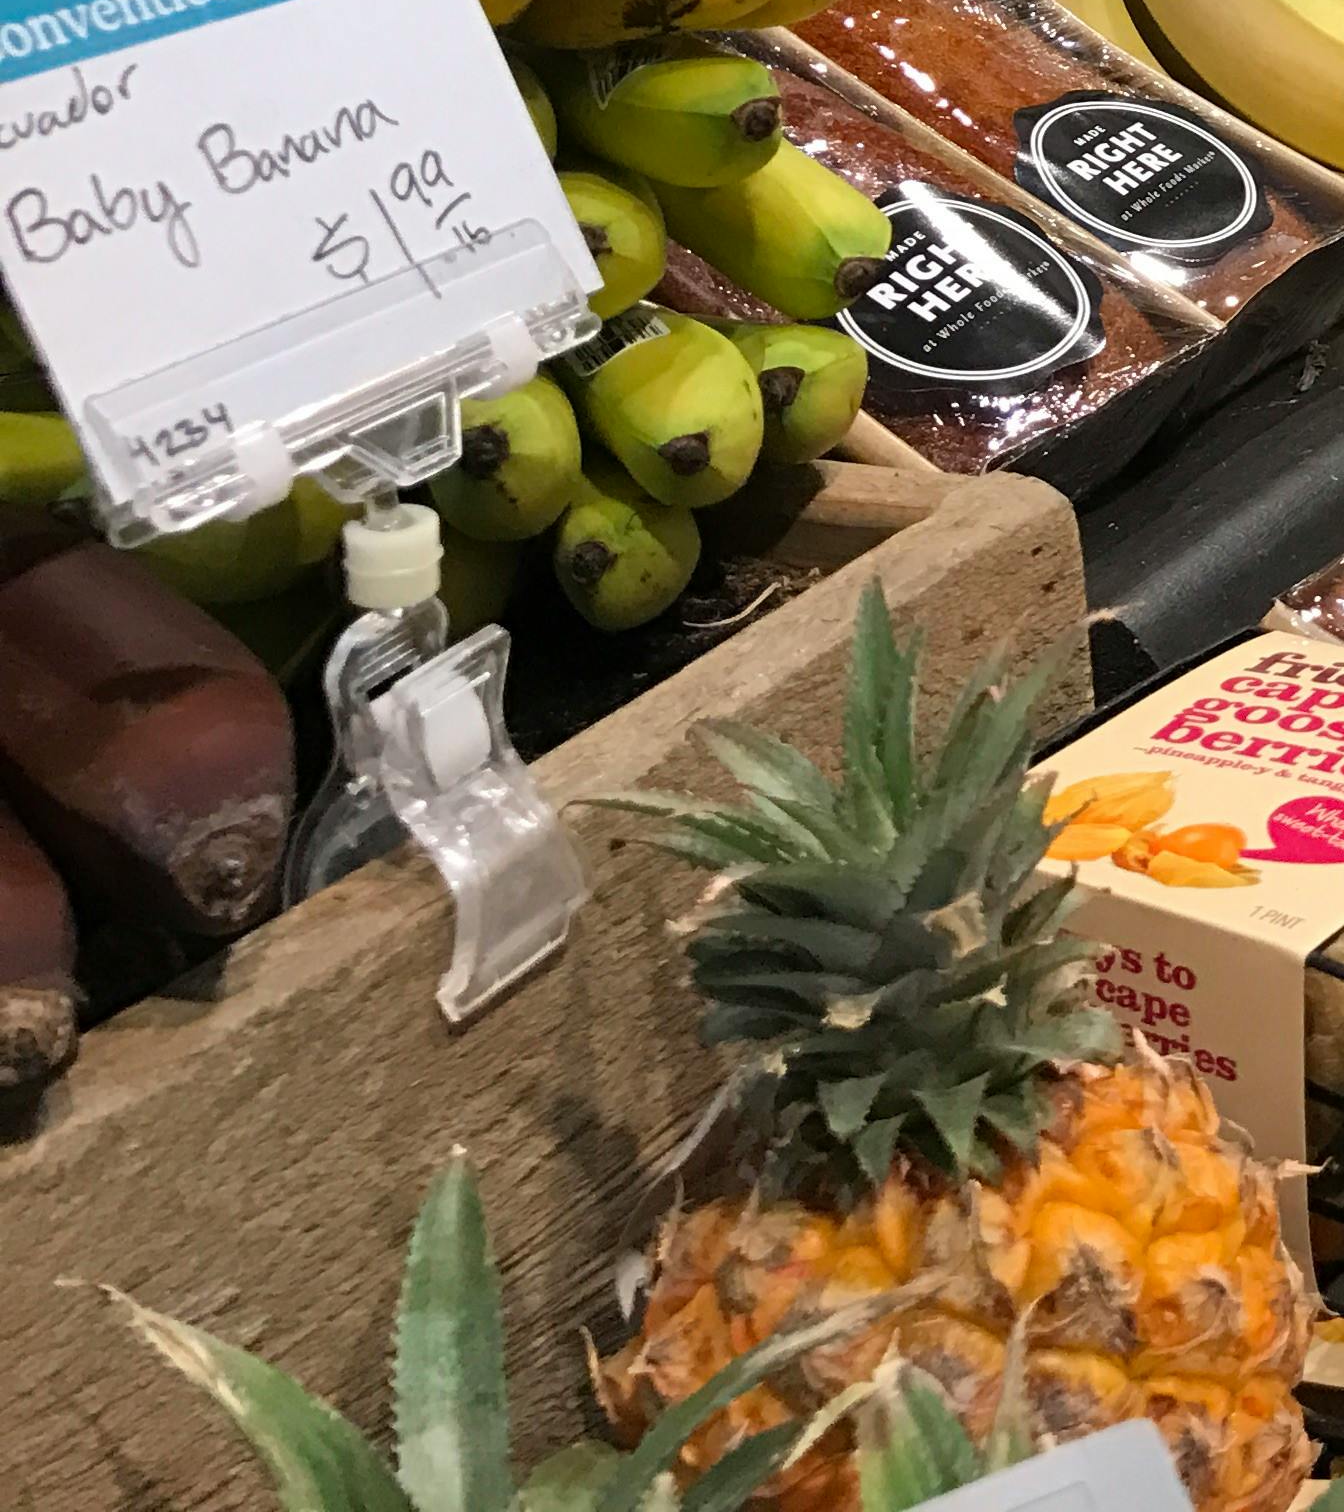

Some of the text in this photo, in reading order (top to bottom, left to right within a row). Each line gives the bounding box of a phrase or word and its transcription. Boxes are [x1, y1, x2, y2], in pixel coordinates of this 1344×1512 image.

[1065, 121, 1158, 183] RIGHT
[1072, 123, 1108, 148] MADE
[4, 98, 400, 268] Baby Banana
[1101, 142, 1184, 197] HERE
[1130, 190, 1161, 213] Whole
[1159, 171, 1187, 193] Foods
[884, 230, 927, 264] MADE
[865, 234, 968, 312] RIGH
[906, 257, 996, 324] HER
[922, 339, 938, 354] at
[935, 311, 976, 341] Whole
[127, 400, 235, 462] 4234
[1260, 907, 1306, 931] PINT
[1153, 951, 1198, 991] to
[1094, 978, 1192, 1027] cape
